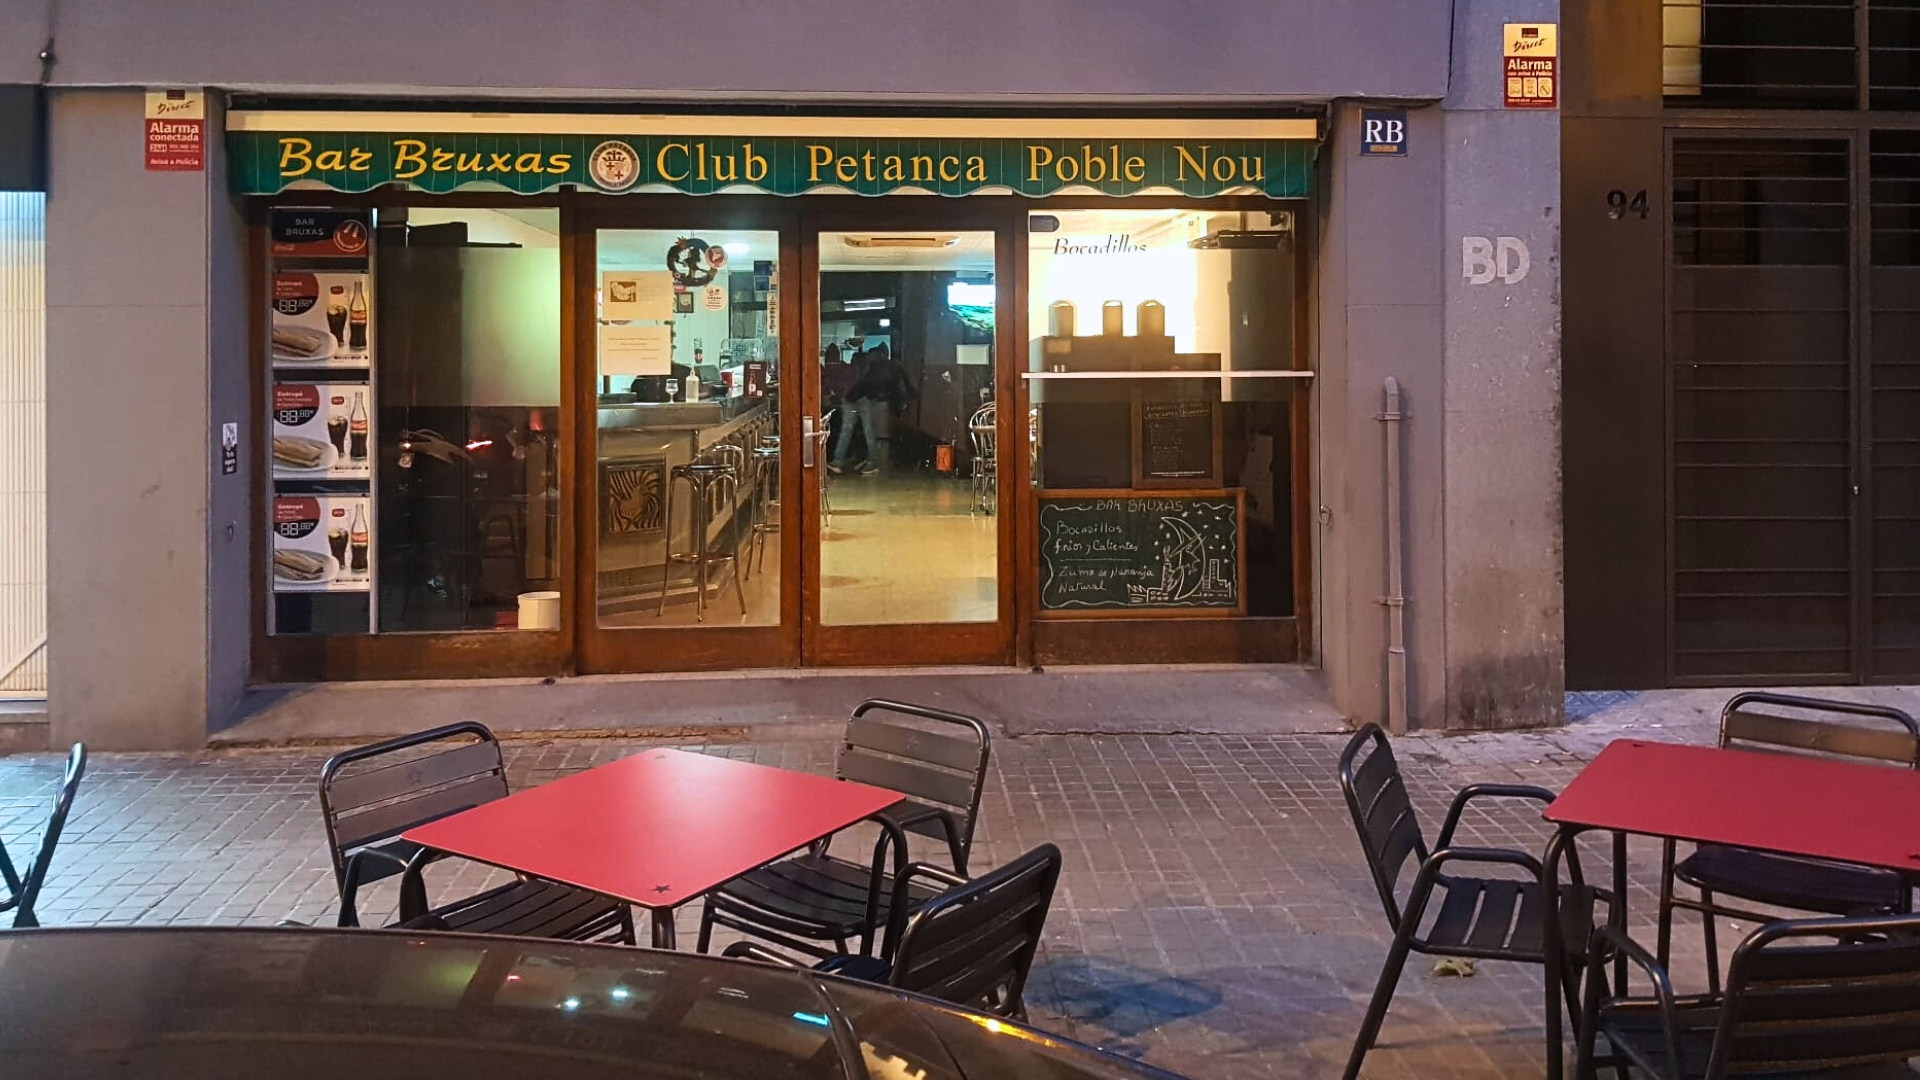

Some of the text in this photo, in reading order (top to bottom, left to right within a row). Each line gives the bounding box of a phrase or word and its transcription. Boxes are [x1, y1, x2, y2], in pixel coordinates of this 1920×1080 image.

[1507, 58, 1553, 70] Alarma
[150, 122, 199, 133] Alarma
[1365, 119, 1404, 143] RB
[149, 133, 199, 141] conectada
[279, 137, 573, 178] Bar Bruxas
[656, 142, 1265, 183] Club Petanca Poble Nou
[1606, 189, 1650, 220] 94
[295, 218, 315, 226] BAR
[285, 228, 325, 236] BRUXAS
[1054, 234, 1147, 255] Bocadillos
[1462, 236, 1531, 285] BD
[1059, 565, 1095, 577] Zumo
[1058, 579, 1107, 594] Natural
